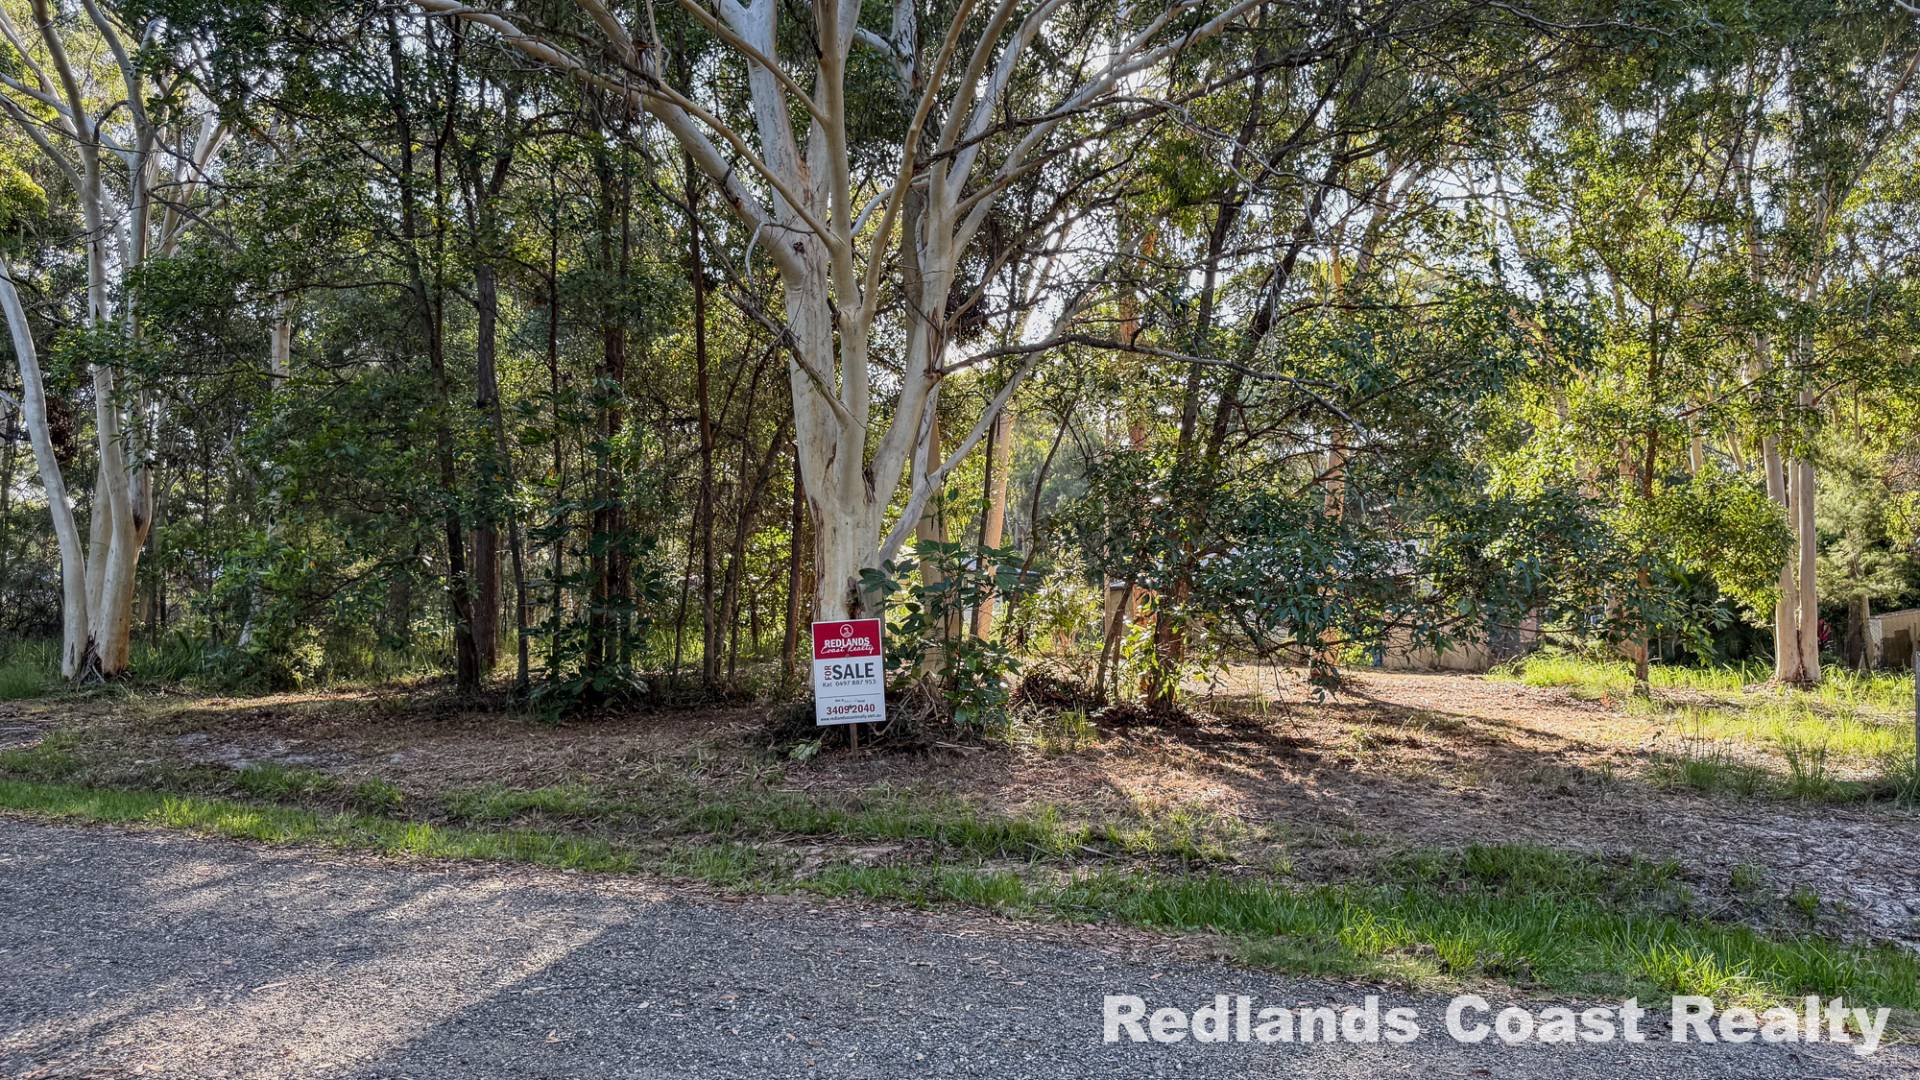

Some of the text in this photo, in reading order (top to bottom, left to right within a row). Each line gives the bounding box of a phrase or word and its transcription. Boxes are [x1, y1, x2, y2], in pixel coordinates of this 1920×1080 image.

[824, 637, 870, 648] REDLANDS
[821, 645, 874, 654] Coast Realty
[824, 665, 832, 680] FOR
[832, 662, 875, 680] SALE
[826, 703, 876, 715] 3409 2040
